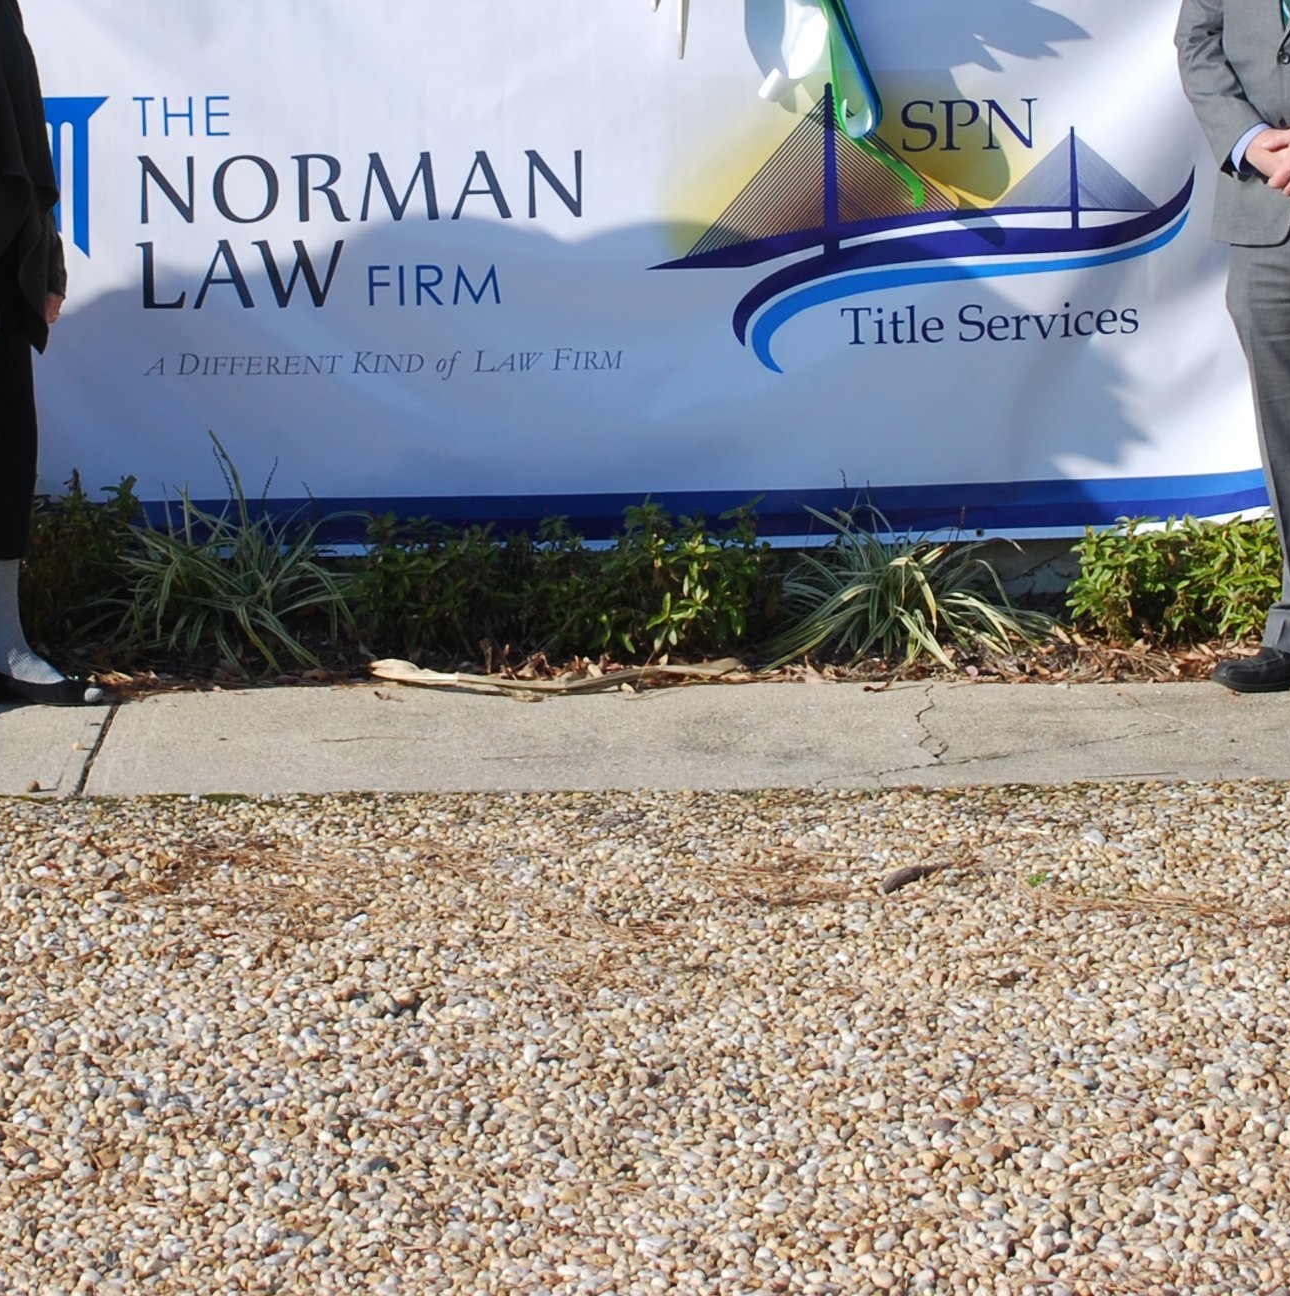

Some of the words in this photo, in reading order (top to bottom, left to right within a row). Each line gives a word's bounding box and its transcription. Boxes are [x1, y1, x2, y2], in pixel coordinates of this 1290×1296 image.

[132, 95, 230, 137] THE
[900, 98, 1038, 152] SPN
[136, 149, 584, 224] NORMAN
[136, 238, 345, 309] LAW
[367, 263, 501, 306] FIRM
[840, 305, 945, 346] Title
[957, 301, 1140, 343] Services
[143, 356, 165, 377] A
[177, 352, 343, 376] DIFFERENT
[351, 351, 425, 375] KIND
[435, 350, 463, 381] of
[473, 350, 543, 373] LAW
[551, 347, 623, 372] FIRM
